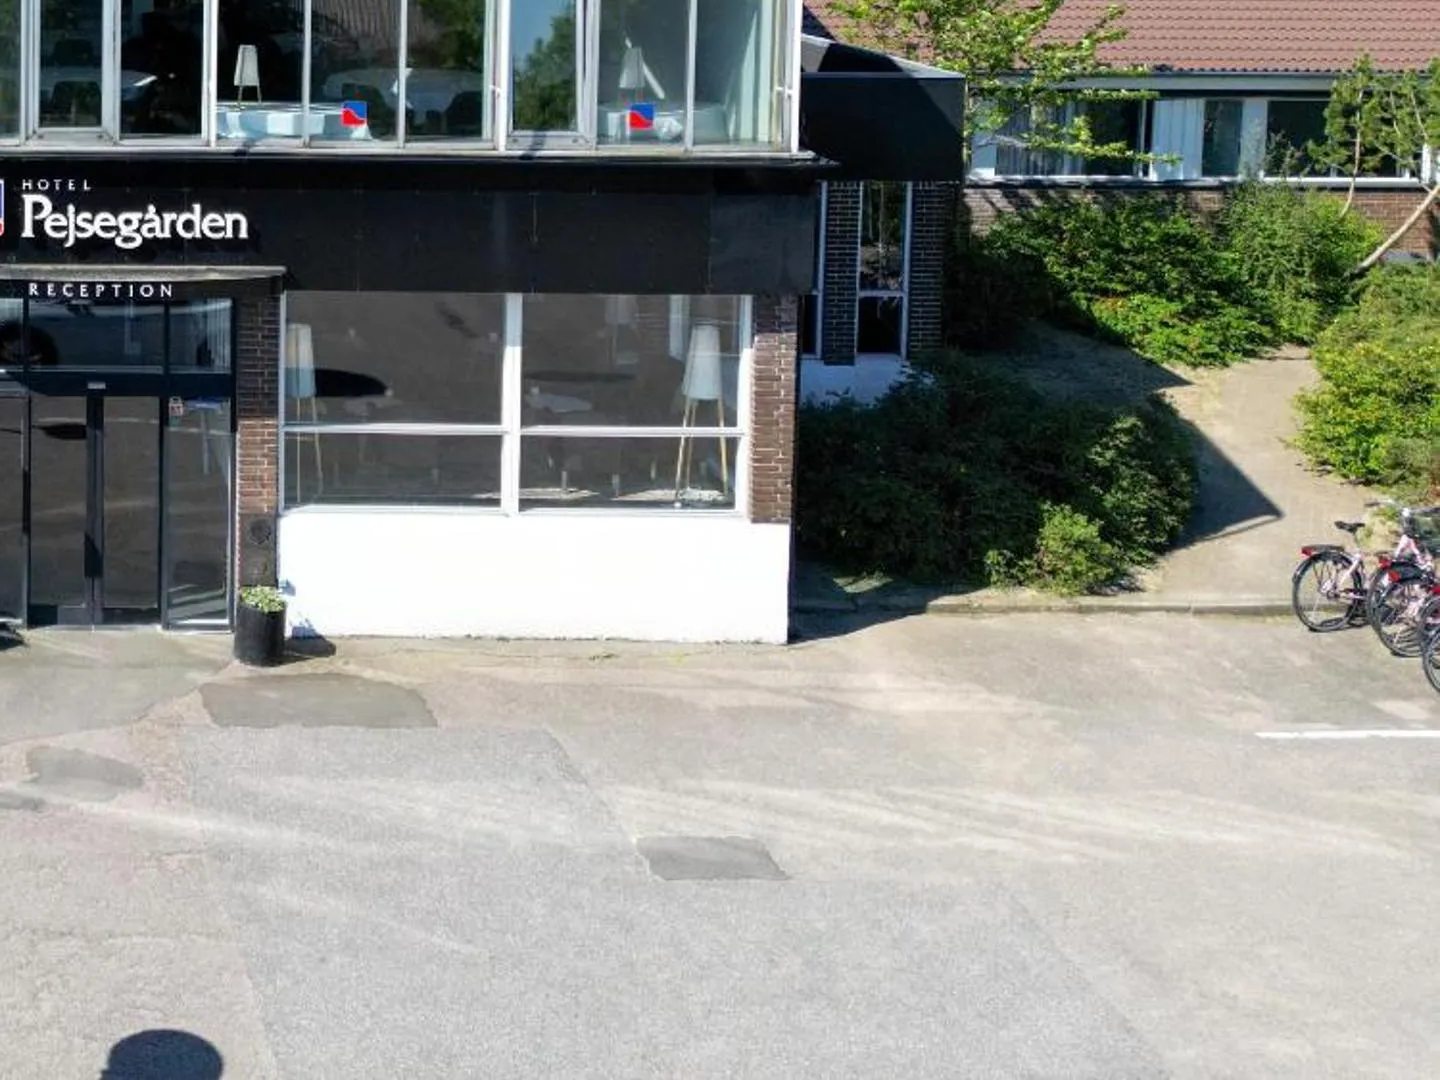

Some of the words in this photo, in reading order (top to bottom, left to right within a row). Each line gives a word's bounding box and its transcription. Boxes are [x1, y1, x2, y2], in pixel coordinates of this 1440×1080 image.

[22, 179, 91, 191] HOTEL
[21, 194, 249, 249] Pejsegården
[28, 283, 173, 298] RECEPTION
